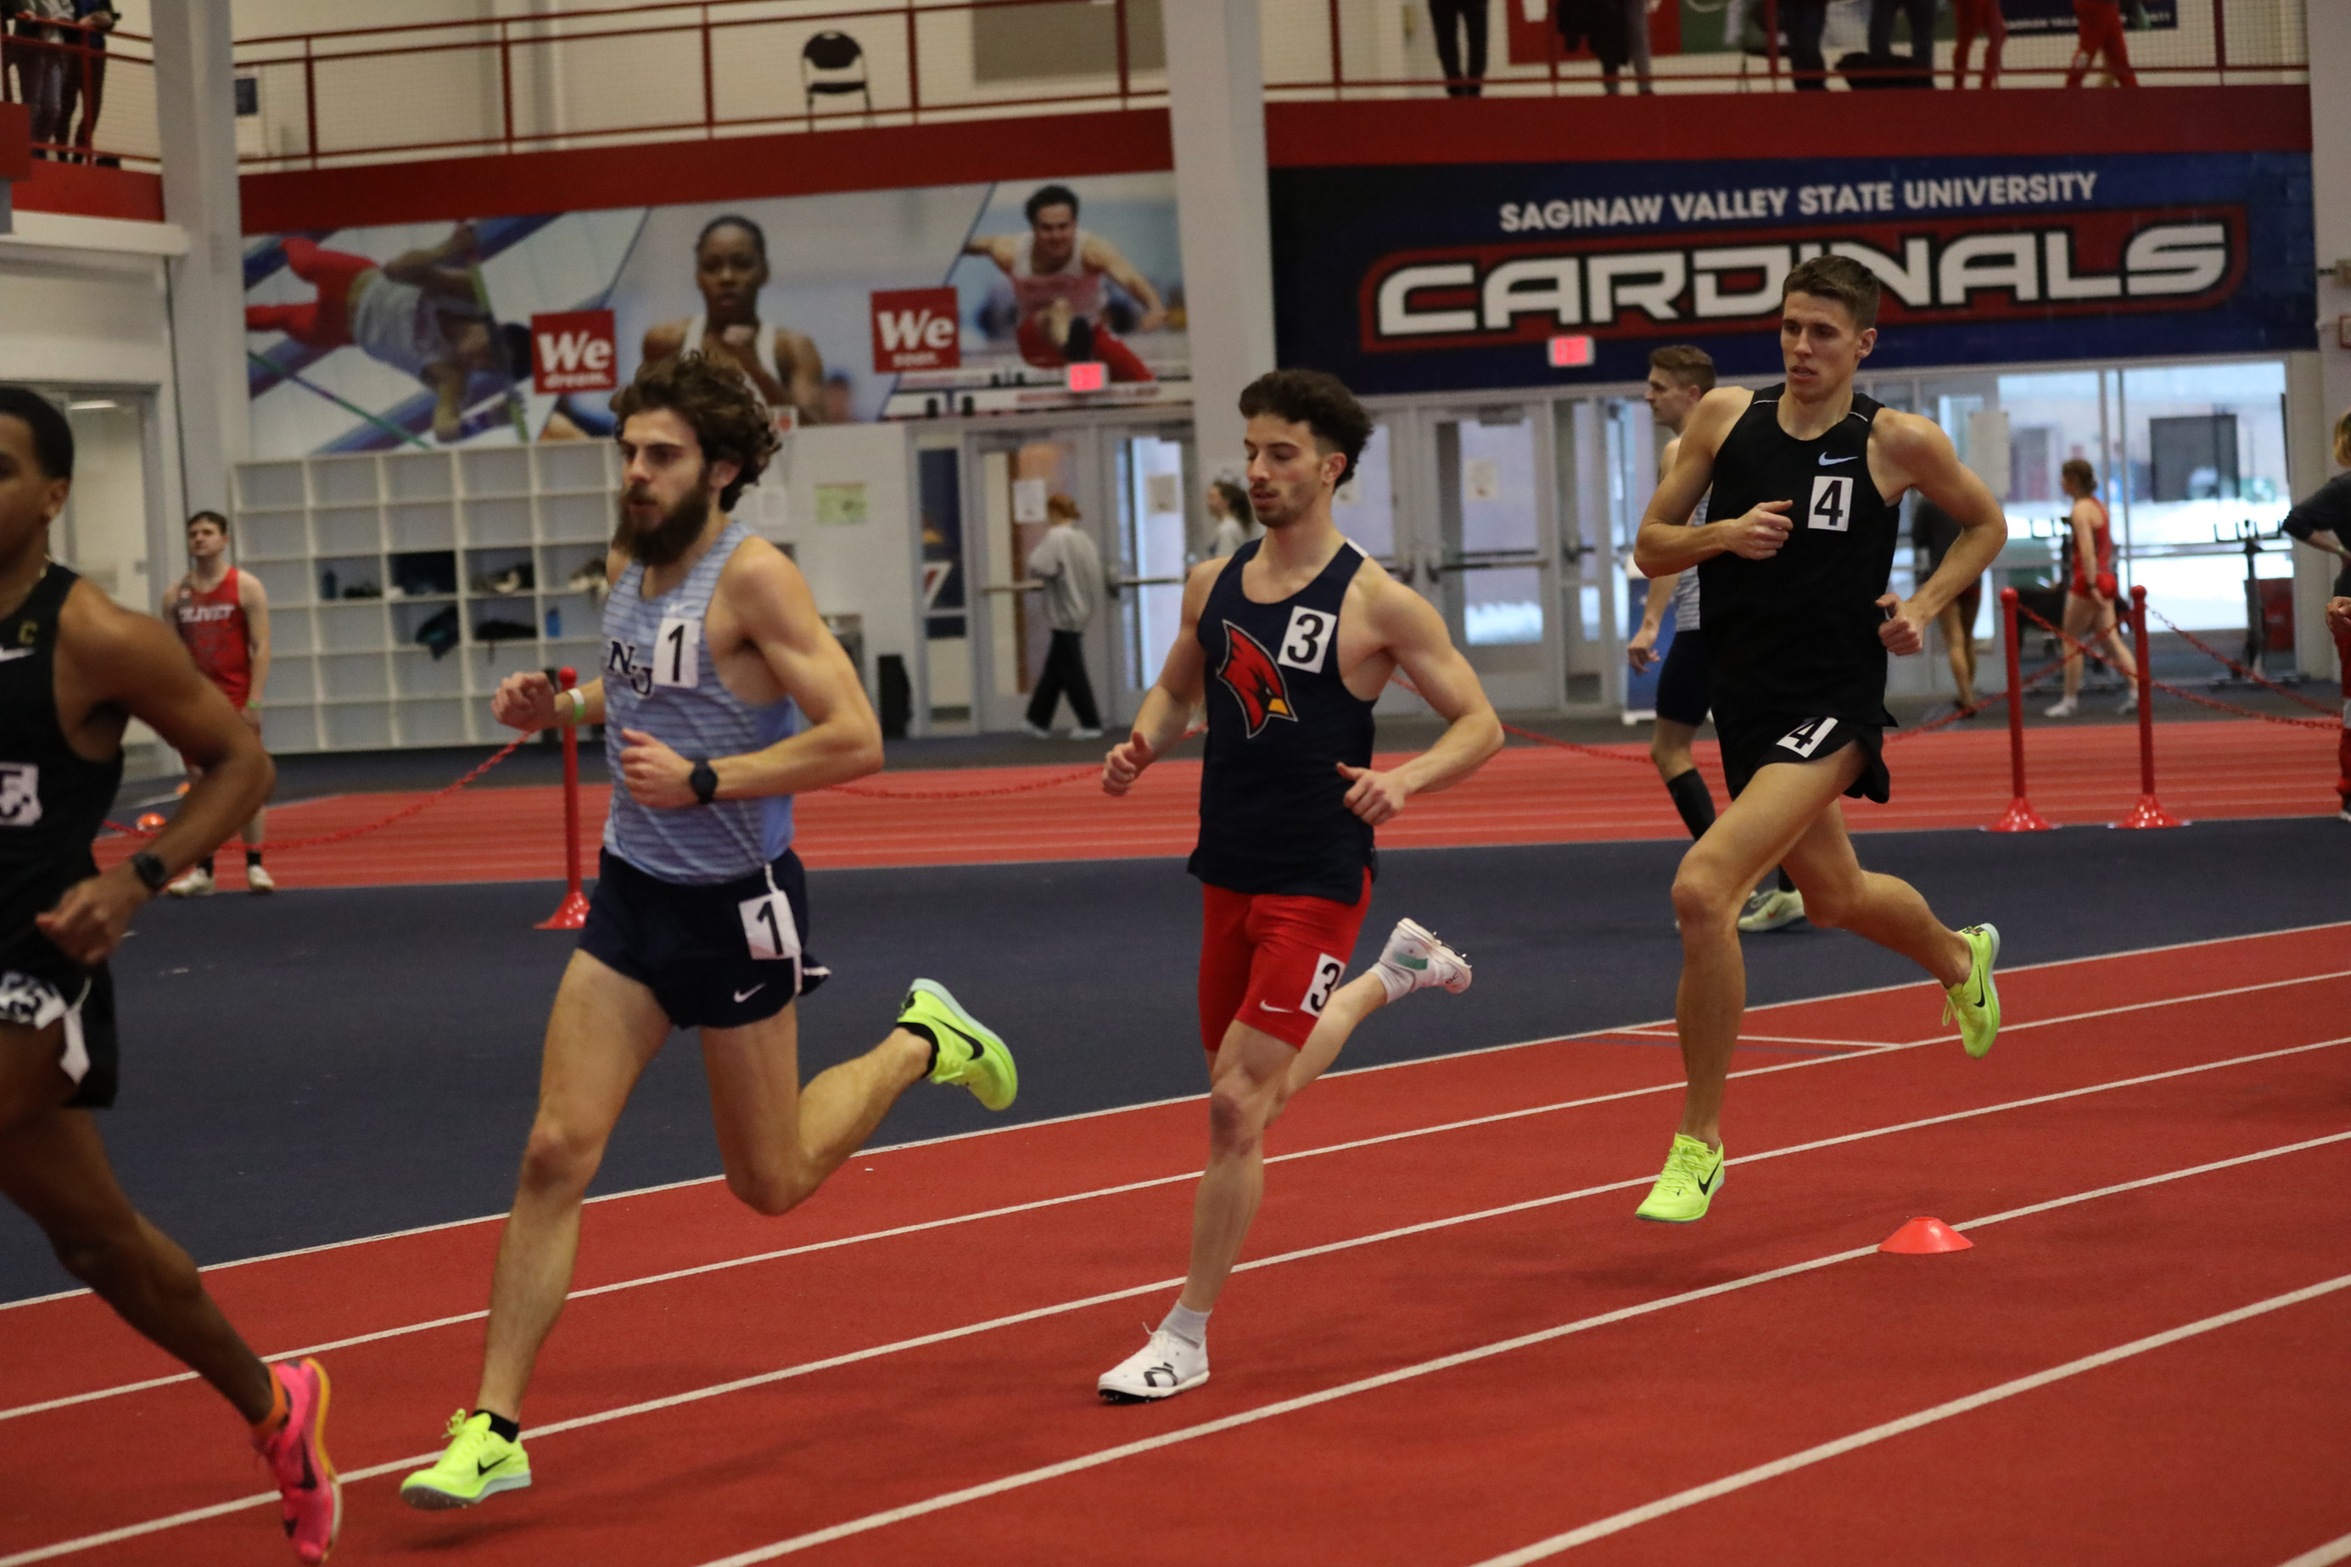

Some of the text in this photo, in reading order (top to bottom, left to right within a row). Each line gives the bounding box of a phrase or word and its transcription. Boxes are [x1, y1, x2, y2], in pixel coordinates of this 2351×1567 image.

[1500, 172, 2098, 232] SAGINAW VALLEY STATE UNIVERSITY
[538, 330, 611, 373] We
[878, 308, 954, 351] We
[1814, 479, 1843, 527] 4
[668, 624, 684, 682] 1
[1287, 613, 1324, 664] 3
[1788, 717, 1827, 750] 4
[756, 900, 783, 956] 1
[1310, 962, 1341, 1013] 3
